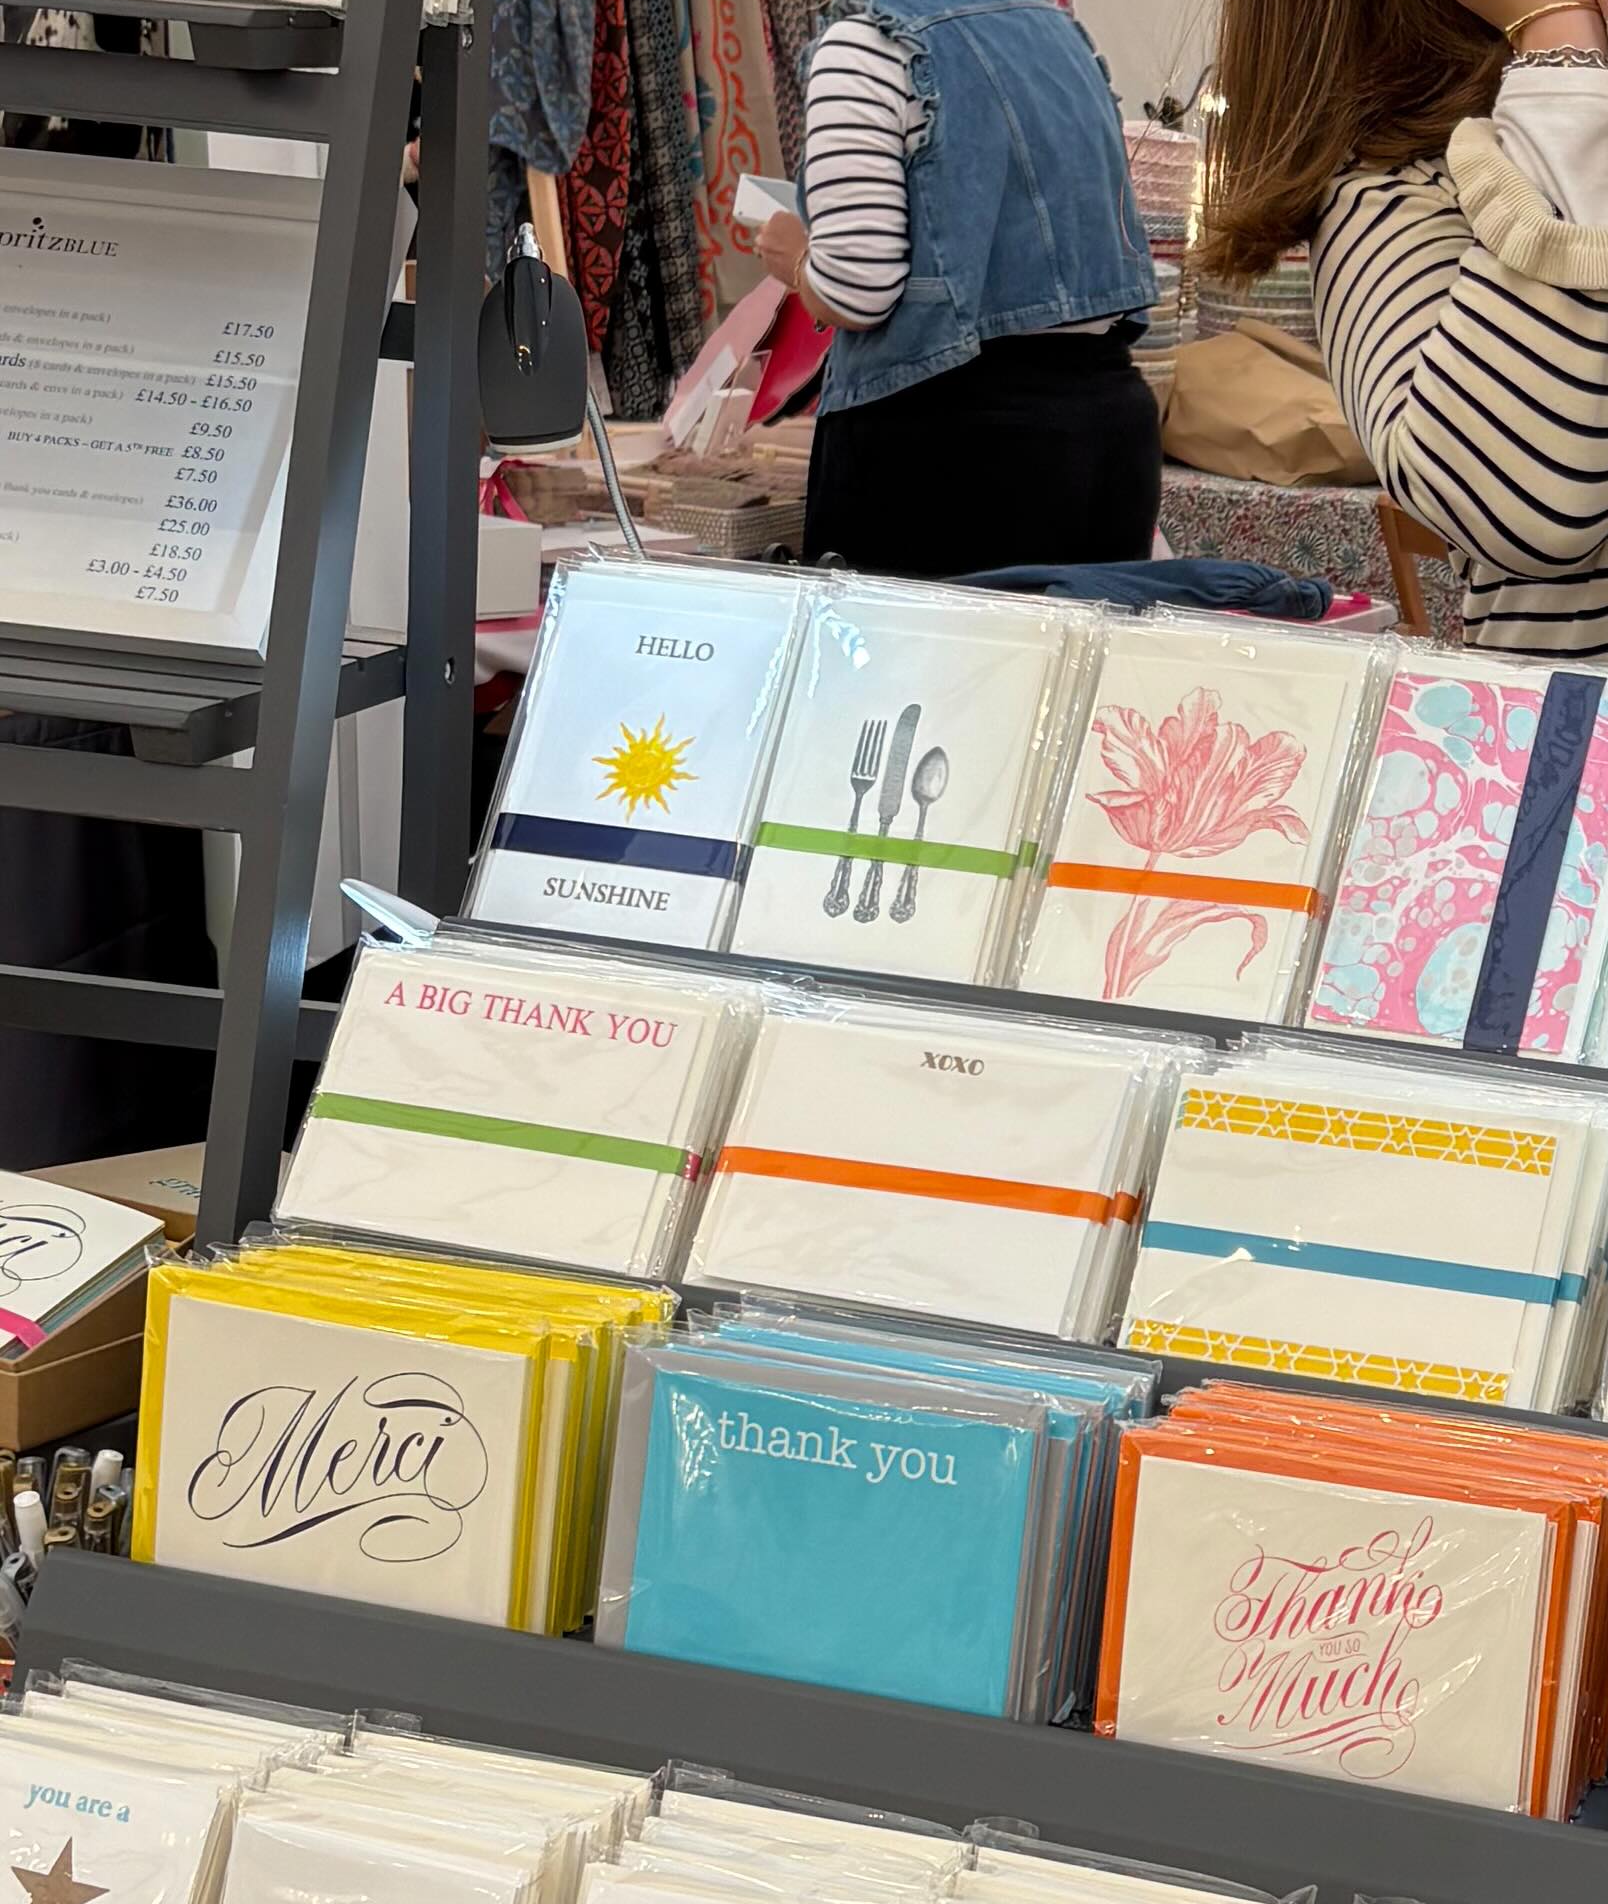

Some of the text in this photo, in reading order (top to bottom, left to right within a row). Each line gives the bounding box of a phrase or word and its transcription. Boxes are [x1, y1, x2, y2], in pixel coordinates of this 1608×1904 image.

[222, 321, 275, 339] £17.50
[213, 350, 265, 367] £15.50
[205, 374, 257, 391] £15.50
[135, 388, 187, 406] £14.50
[200, 395, 252, 413] £16.50
[189, 422, 233, 440] £9.50
[181, 445, 225, 463] £8.50
[174, 467, 218, 484] £7.50
[165, 495, 217, 513] £36.00
[158, 518, 210, 536] £25.00
[149, 542, 202, 561] £18.50
[86, 559, 130, 576] £3.00
[143, 565, 187, 582] £4.50
[135, 585, 179, 603] £7.50
[635, 634, 715, 662] HELLO
[543, 876, 670, 912] SUNSHINE
[384, 981, 679, 1048] A BIG THANK YOU
[919, 1050, 985, 1077] XOXO
[188, 1372, 488, 1520] Merci
[717, 1408, 957, 1486] thank you
[1213, 1515, 1443, 1643] Thank
[1318, 1638, 1361, 1656] YOU SO
[1217, 1623, 1420, 1732] Much
[24, 1782, 131, 1824] you are a
